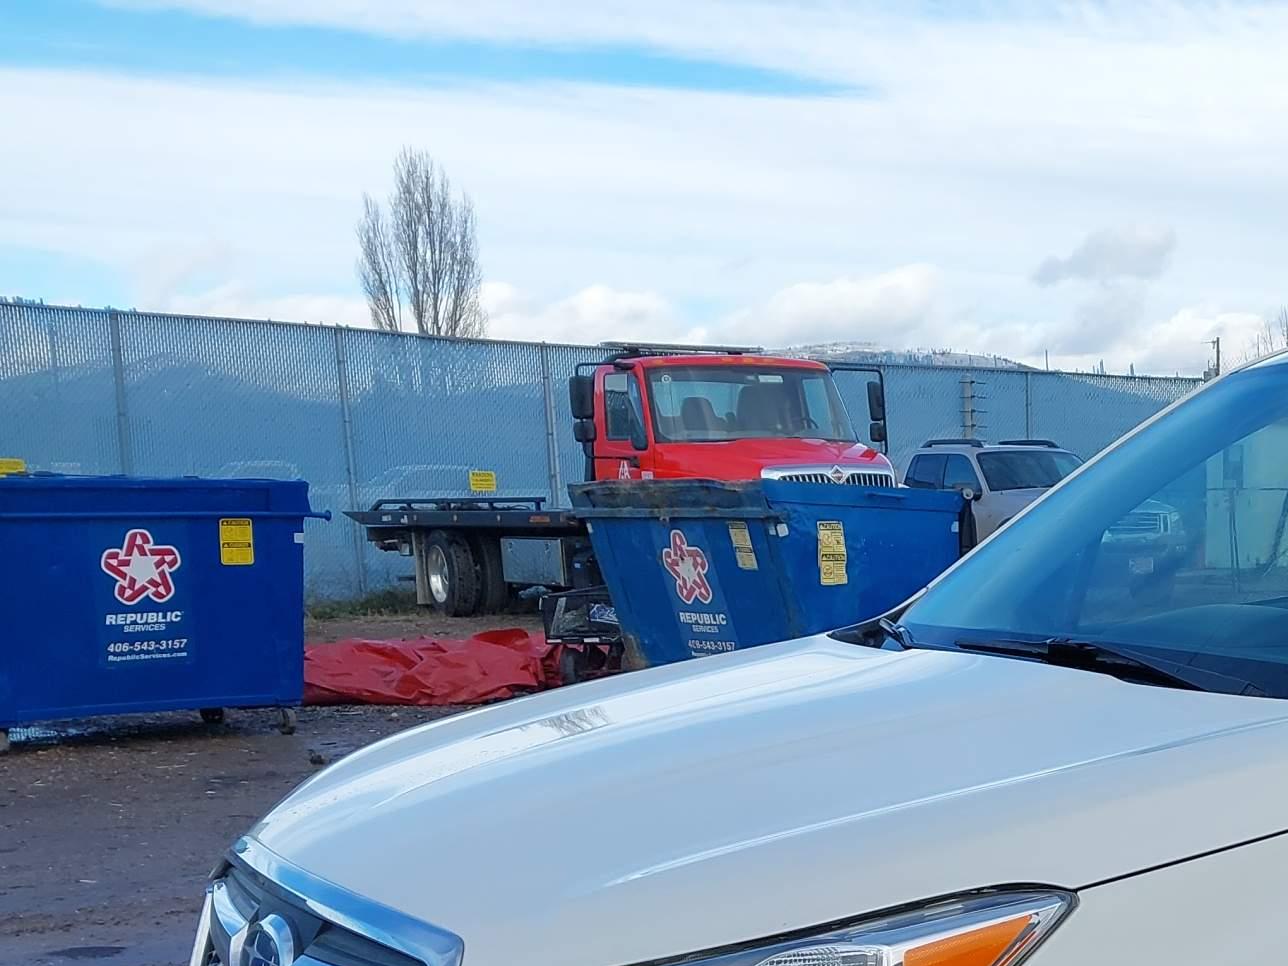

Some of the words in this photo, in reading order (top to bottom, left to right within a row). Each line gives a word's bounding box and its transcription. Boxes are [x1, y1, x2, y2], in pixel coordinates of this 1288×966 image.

[105, 611, 183, 625] REPUBLIC
[679, 612, 727, 625] REPUBLIC
[123, 624, 166, 632] SERVICES
[107, 639, 188, 653] 406-543-3157
[108, 652, 188, 661] RepublicServices.com
